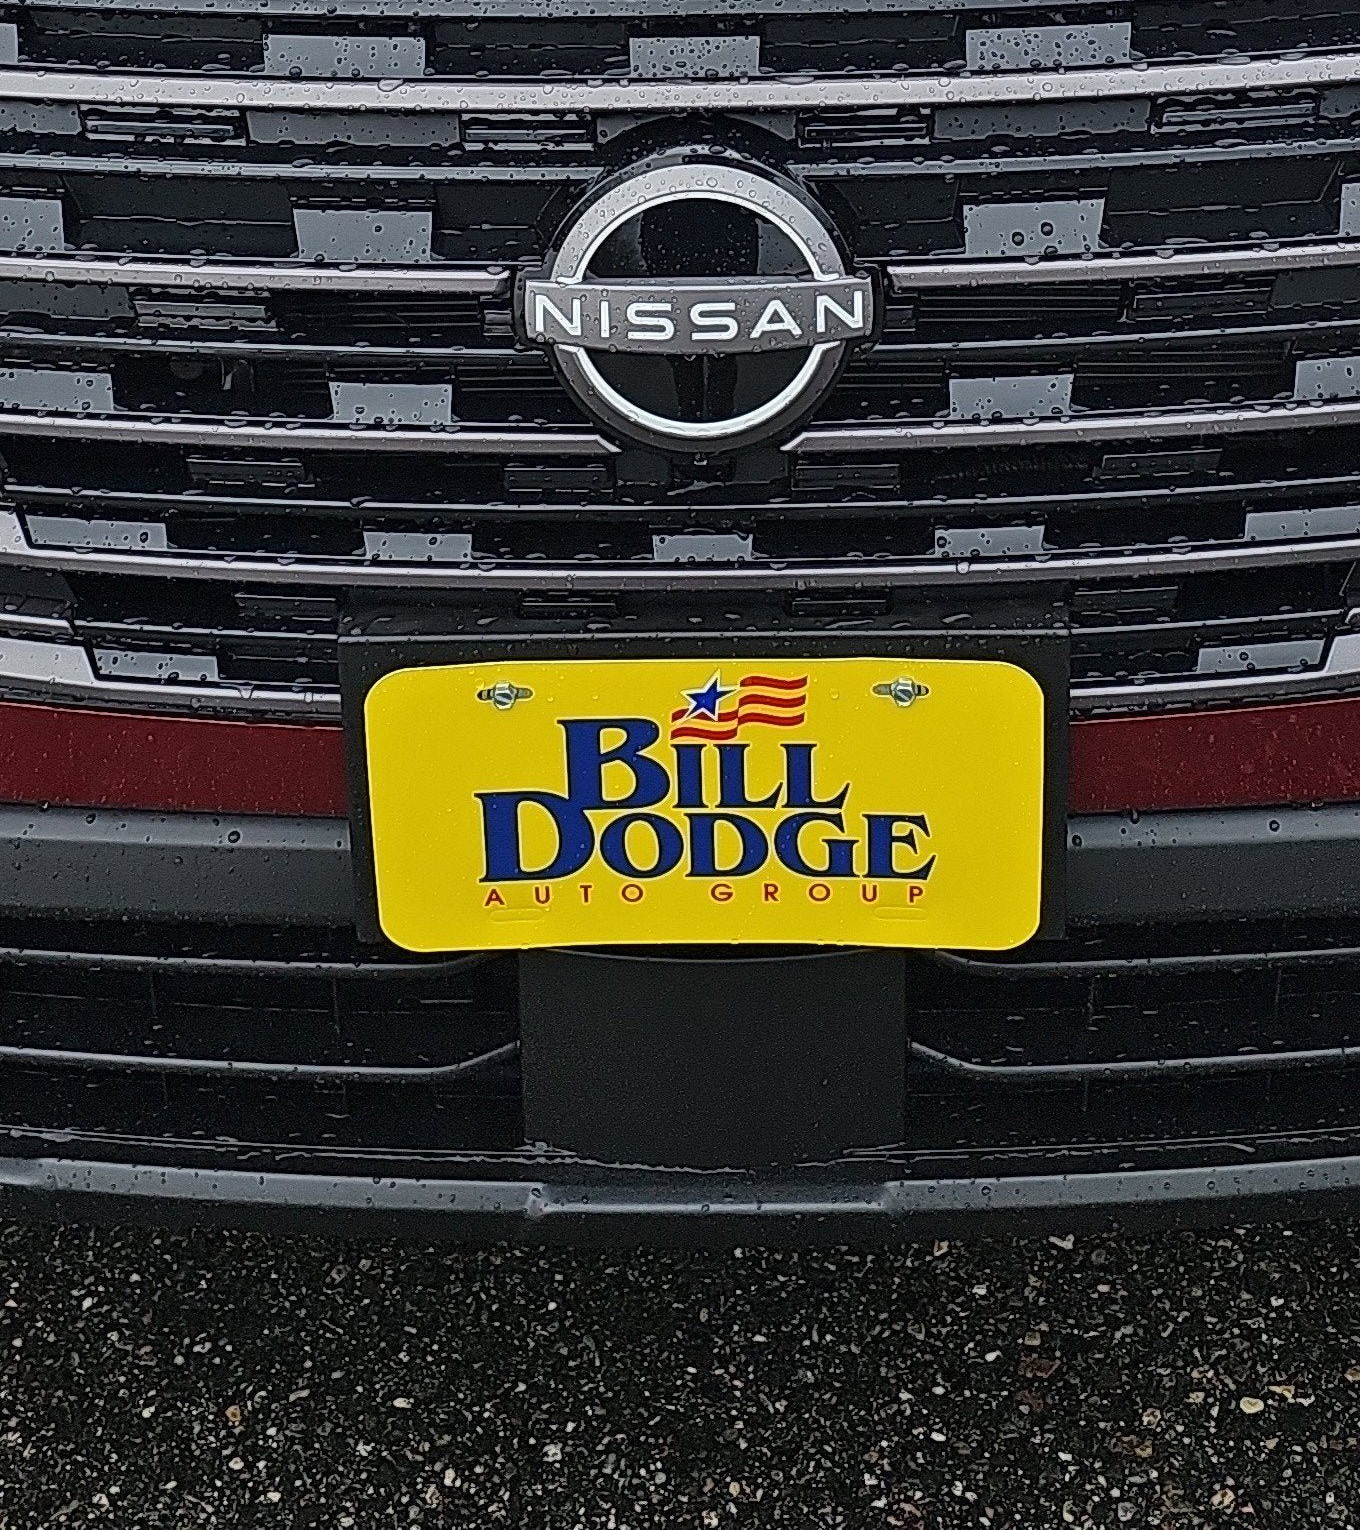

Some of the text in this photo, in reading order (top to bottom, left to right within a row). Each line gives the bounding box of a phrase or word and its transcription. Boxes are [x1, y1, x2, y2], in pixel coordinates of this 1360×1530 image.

[535, 290, 863, 340] NISSAN
[557, 718, 851, 809] BILL
[474, 791, 937, 882] DODGE
[483, 883, 924, 907] AUTO GROUP
